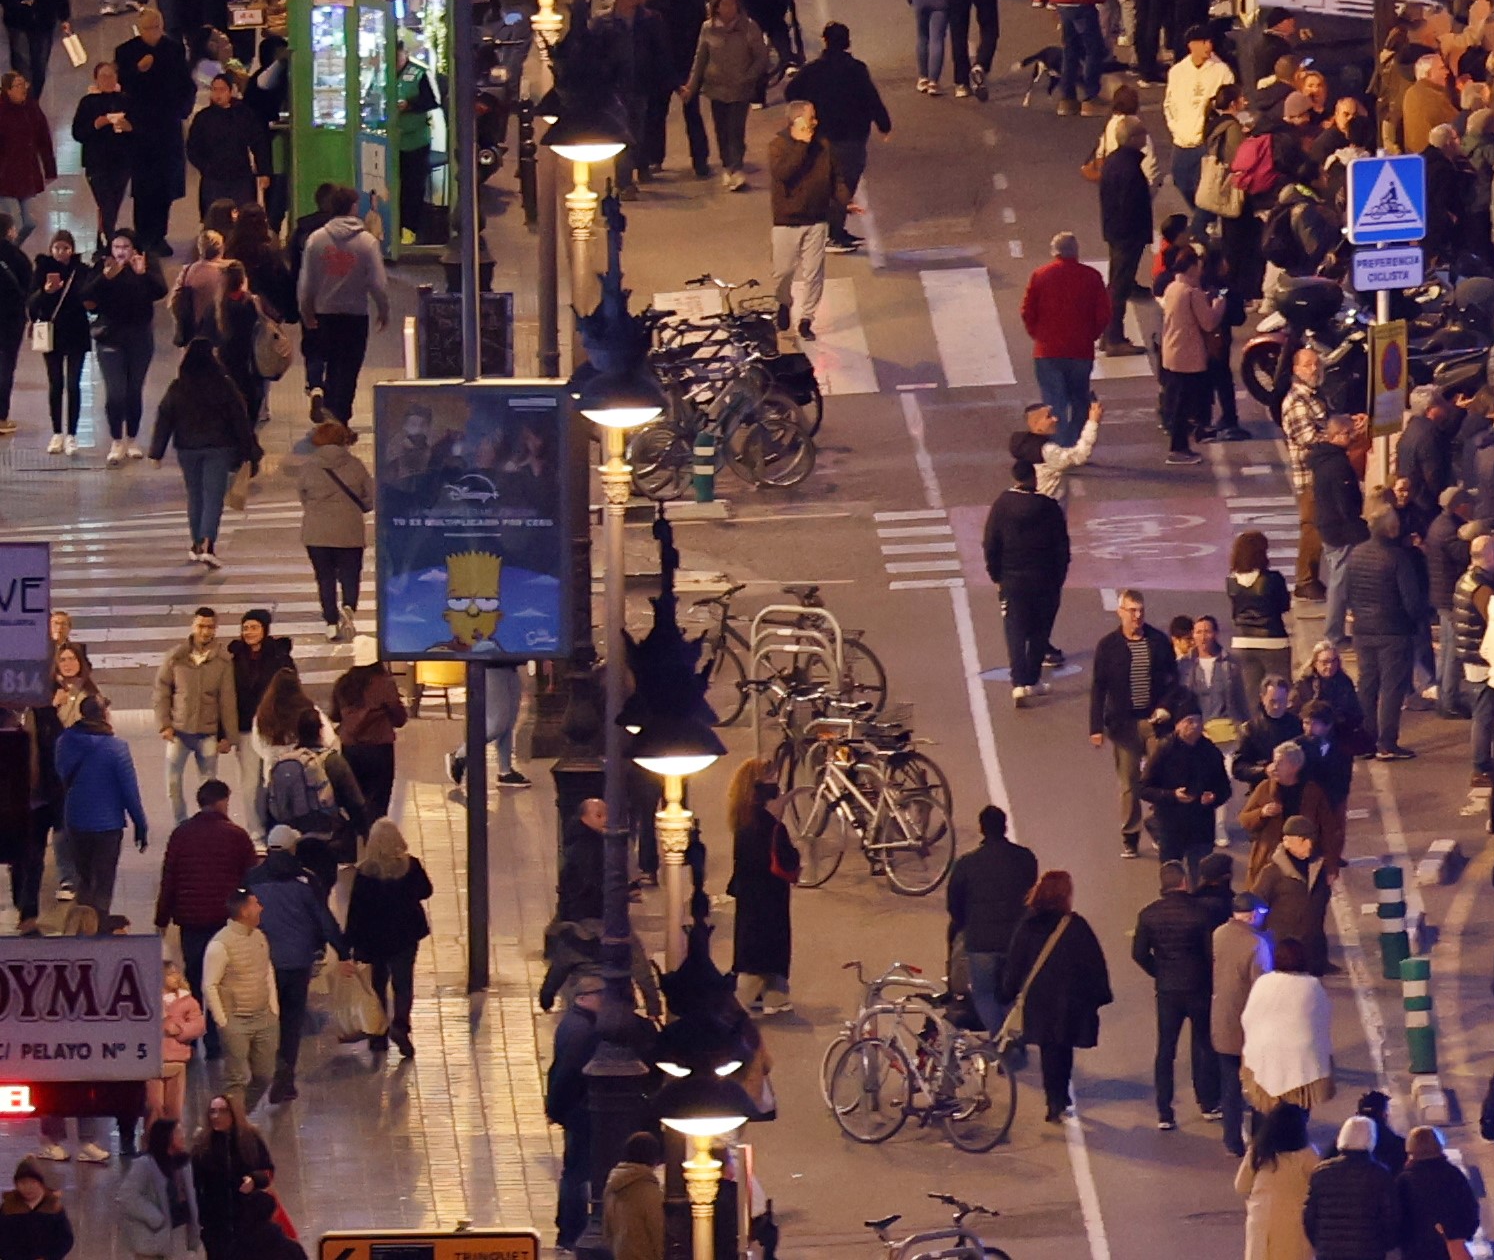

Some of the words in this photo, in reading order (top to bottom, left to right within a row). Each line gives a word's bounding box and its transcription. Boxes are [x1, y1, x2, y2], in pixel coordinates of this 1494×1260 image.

[1356, 255, 1420, 269] PREFERENCIA
[1367, 271, 1410, 283] CICLISTA
[21, 1043, 92, 1060] PELAYO
[137, 1044, 148, 1060] 5
